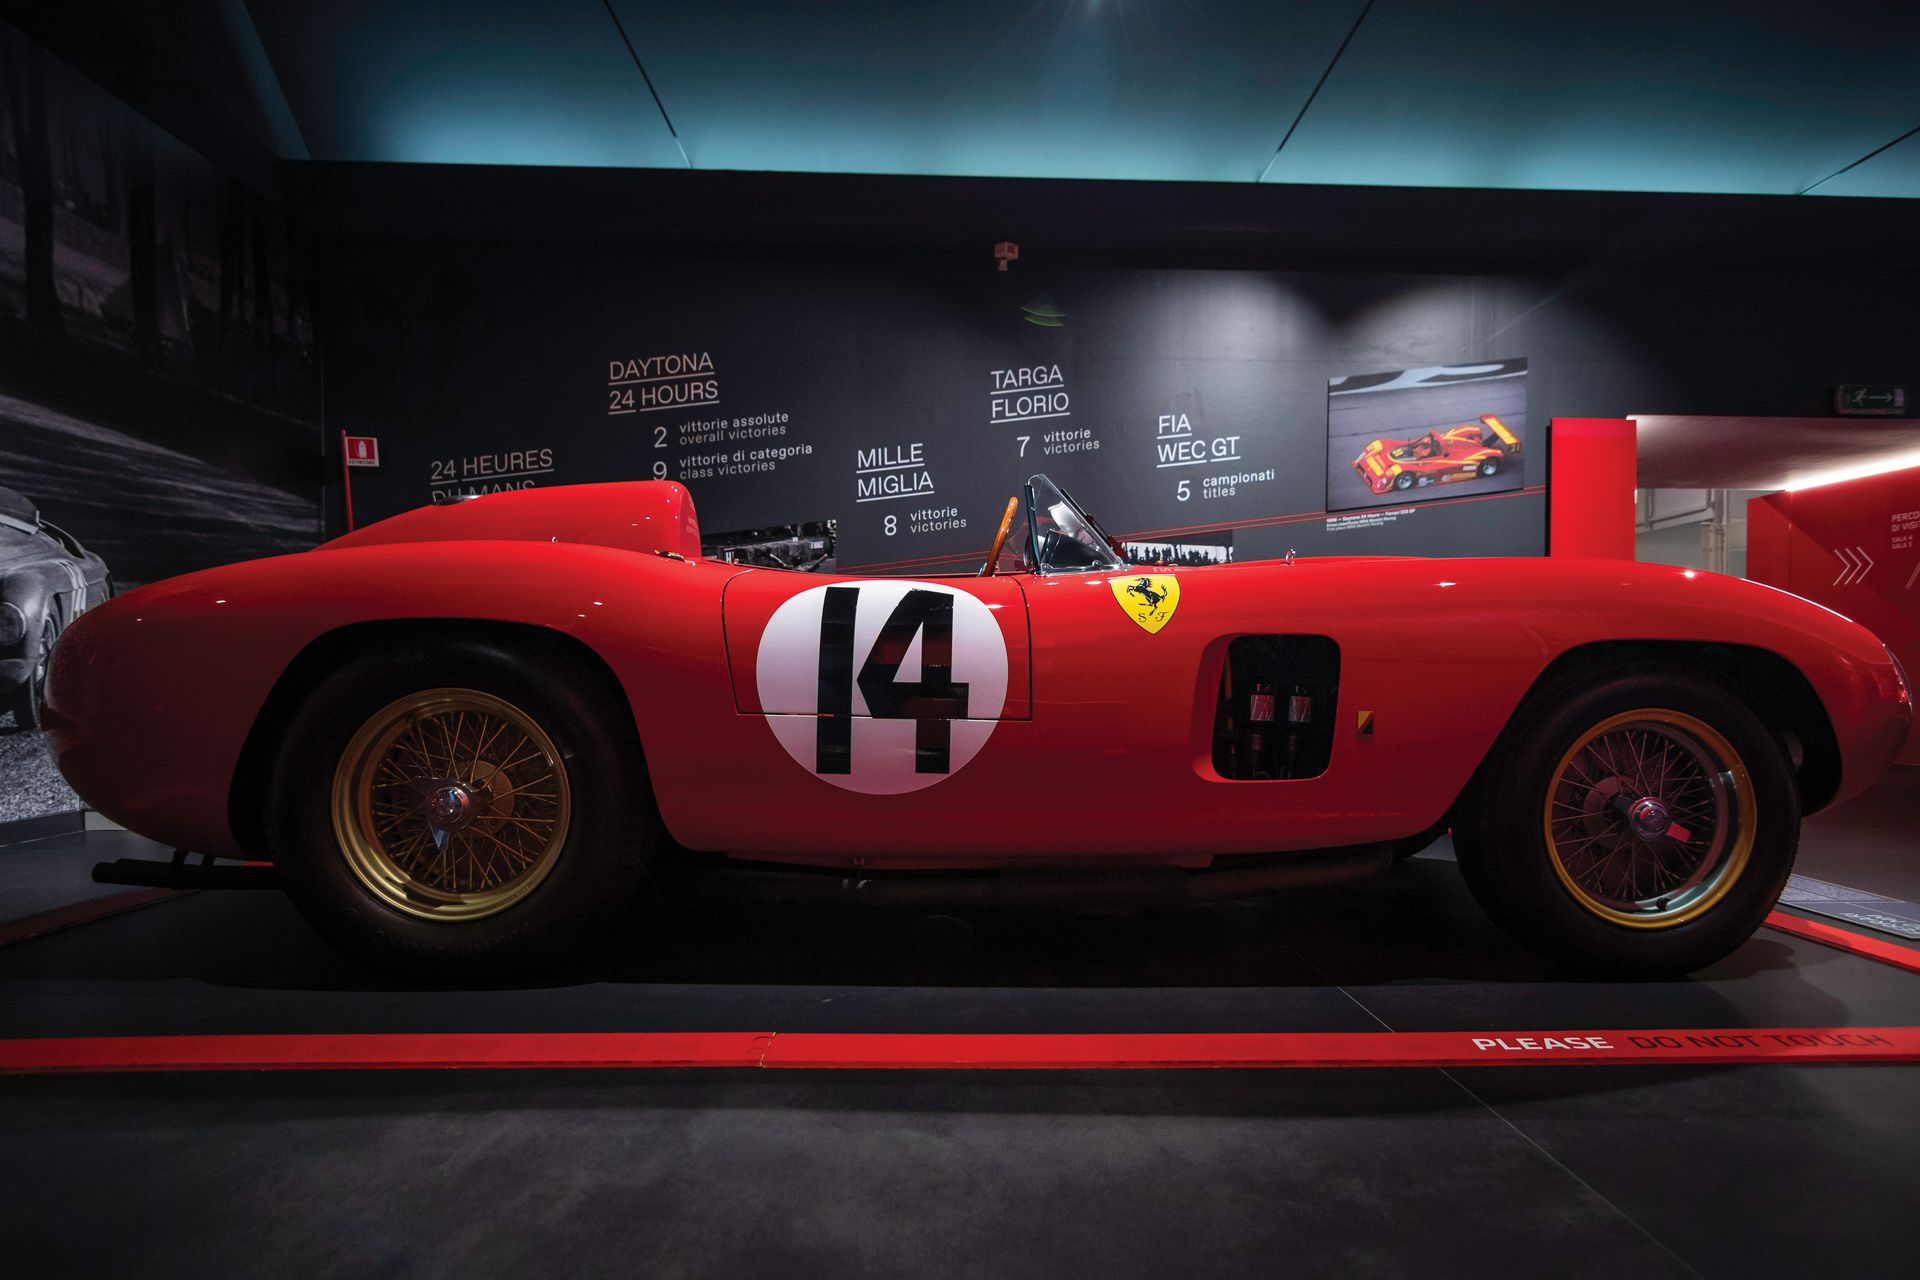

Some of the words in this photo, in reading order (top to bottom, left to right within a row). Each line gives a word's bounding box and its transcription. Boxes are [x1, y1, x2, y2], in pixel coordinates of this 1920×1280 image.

[610, 352, 714, 380] DAYTONA
[990, 365, 1063, 388] TARGA
[610, 389, 635, 410] 24
[642, 380, 718, 407] HOURS
[992, 393, 1069, 418] FLORIO
[680, 418, 728, 433] vittorie
[733, 412, 789, 429] assolute
[1159, 414, 1192, 434] FIA
[654, 427, 667, 448] 2
[680, 431, 724, 446] overall
[730, 424, 786, 439] victories
[1044, 428, 1091, 443] vittorie
[680, 453, 728, 468] vittorie
[733, 449, 745, 462] di
[750, 444, 812, 464] categoria
[857, 444, 924, 468] MILLE
[1017, 436, 1030, 457] 7
[1044, 439, 1100, 455] victories
[1158, 441, 1206, 463] WEC
[1211, 436, 1240, 457] GT
[431, 459, 456, 480] 24
[463, 448, 552, 476] HEURES
[653, 461, 667, 481] 9
[680, 466, 714, 480] class
[718, 459, 776, 475] victories
[857, 471, 933, 497] MIGLIA
[1203, 469, 1275, 486] campionati
[1177, 480, 1190, 501] 5
[1203, 485, 1236, 499] titles
[910, 507, 958, 520] vittorie
[1891, 510, 1920, 522] PERCO
[884, 515, 897, 536] 8
[910, 517, 966, 533] victories
[1902, 521, 1920, 530] VISI
[1138, 610, 1147, 623] S
[1155, 608, 1168, 622] F
[815, 585, 970, 775] 14
[1472, 1036, 1614, 1051] PLEASE
[1629, 1035, 1682, 1049] DO
[1688, 1035, 1758, 1049] NOT
[1762, 1034, 1892, 1049] TOUCH
